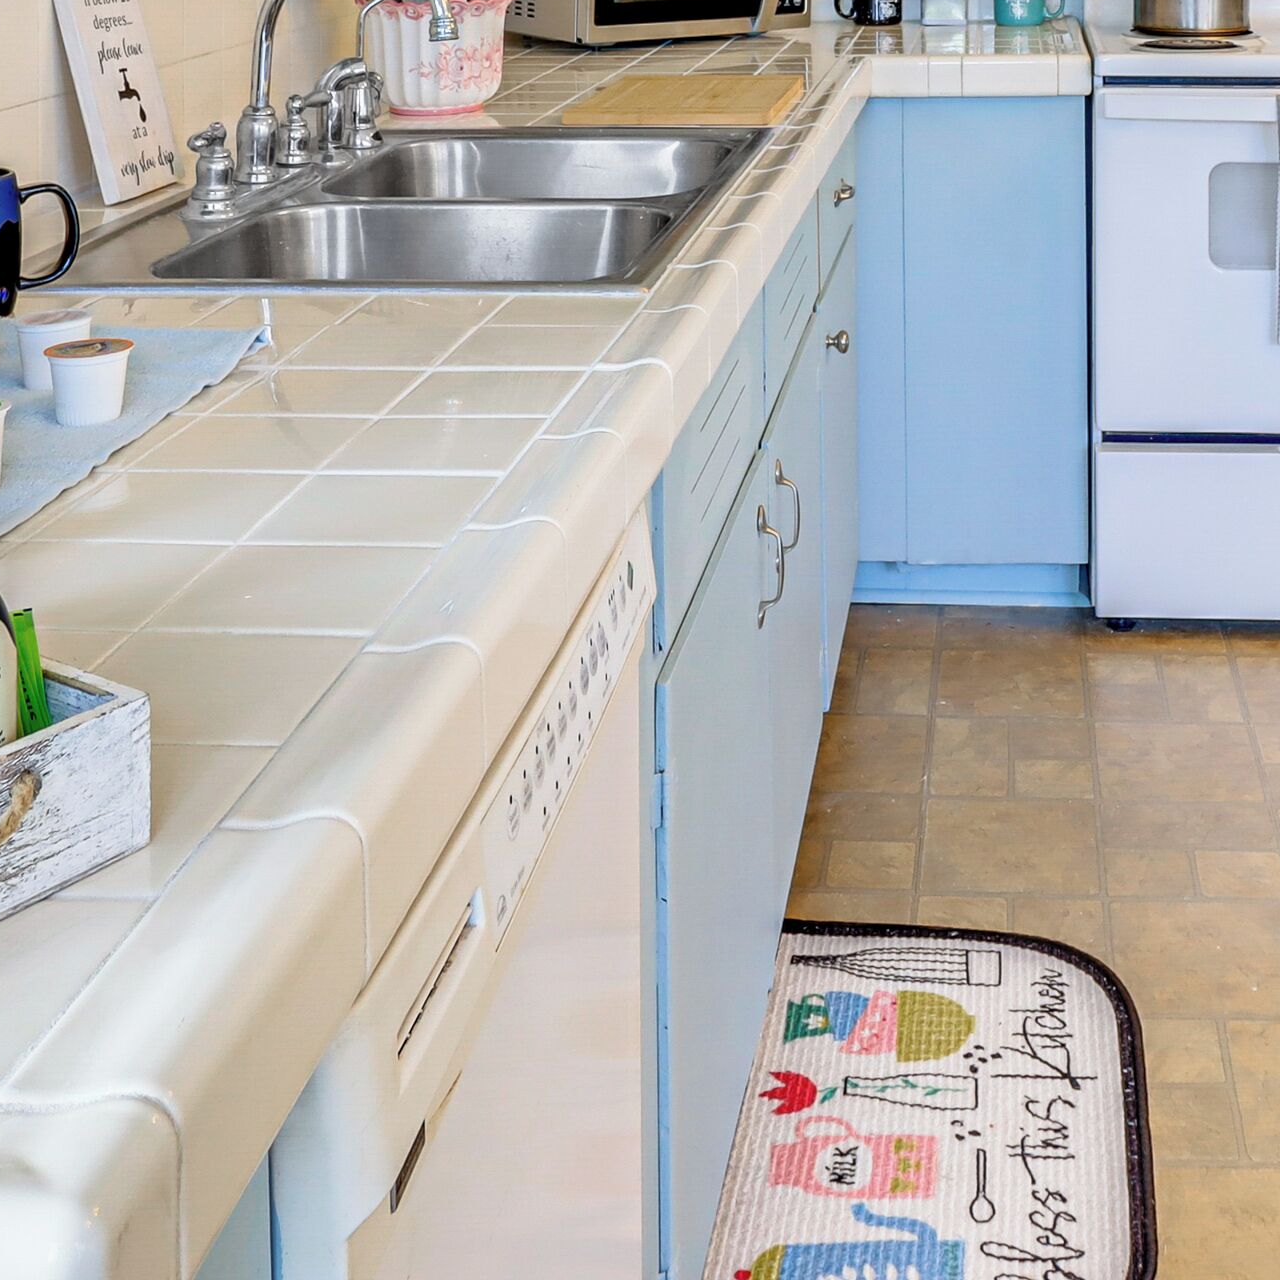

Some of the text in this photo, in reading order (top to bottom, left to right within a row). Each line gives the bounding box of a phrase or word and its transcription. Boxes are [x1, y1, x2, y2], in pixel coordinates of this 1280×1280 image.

[98, 38, 144, 74] please leave
[132, 126, 142, 140] at
[121, 145, 175, 186] very slow drip
[1005, 1094, 1076, 1184] this
